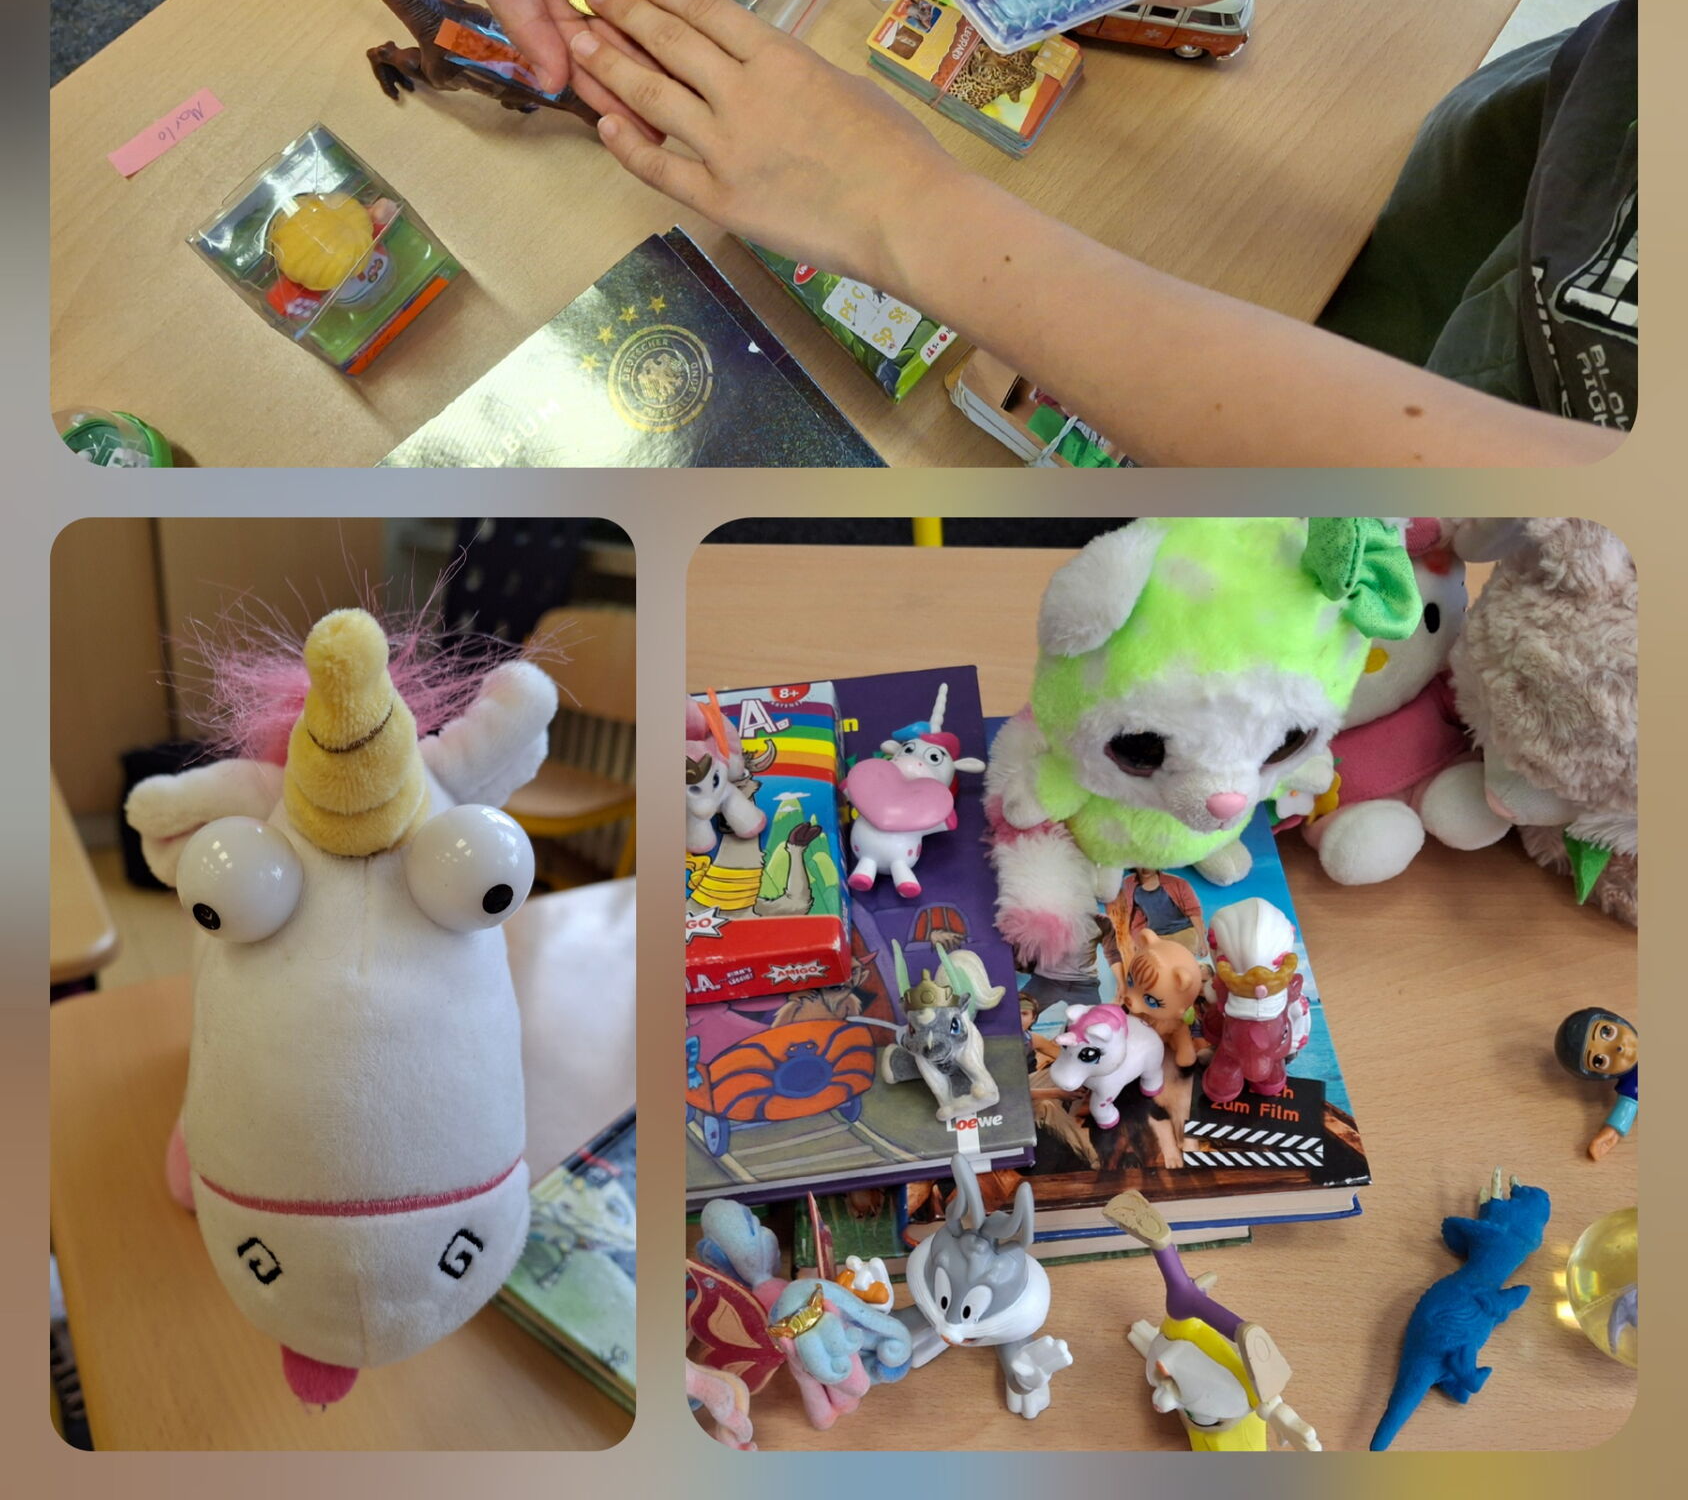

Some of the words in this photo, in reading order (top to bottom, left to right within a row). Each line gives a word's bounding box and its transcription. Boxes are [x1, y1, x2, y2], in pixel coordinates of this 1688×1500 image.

[951, 25, 976, 61] LEOPARD
[478, 399, 562, 468] LBUM
[779, 687, 800, 699] 8+
[776, 965, 818, 978] AMIGO
[1259, 1103, 1300, 1122] Film
[946, 1114, 1004, 1133] Loewe
